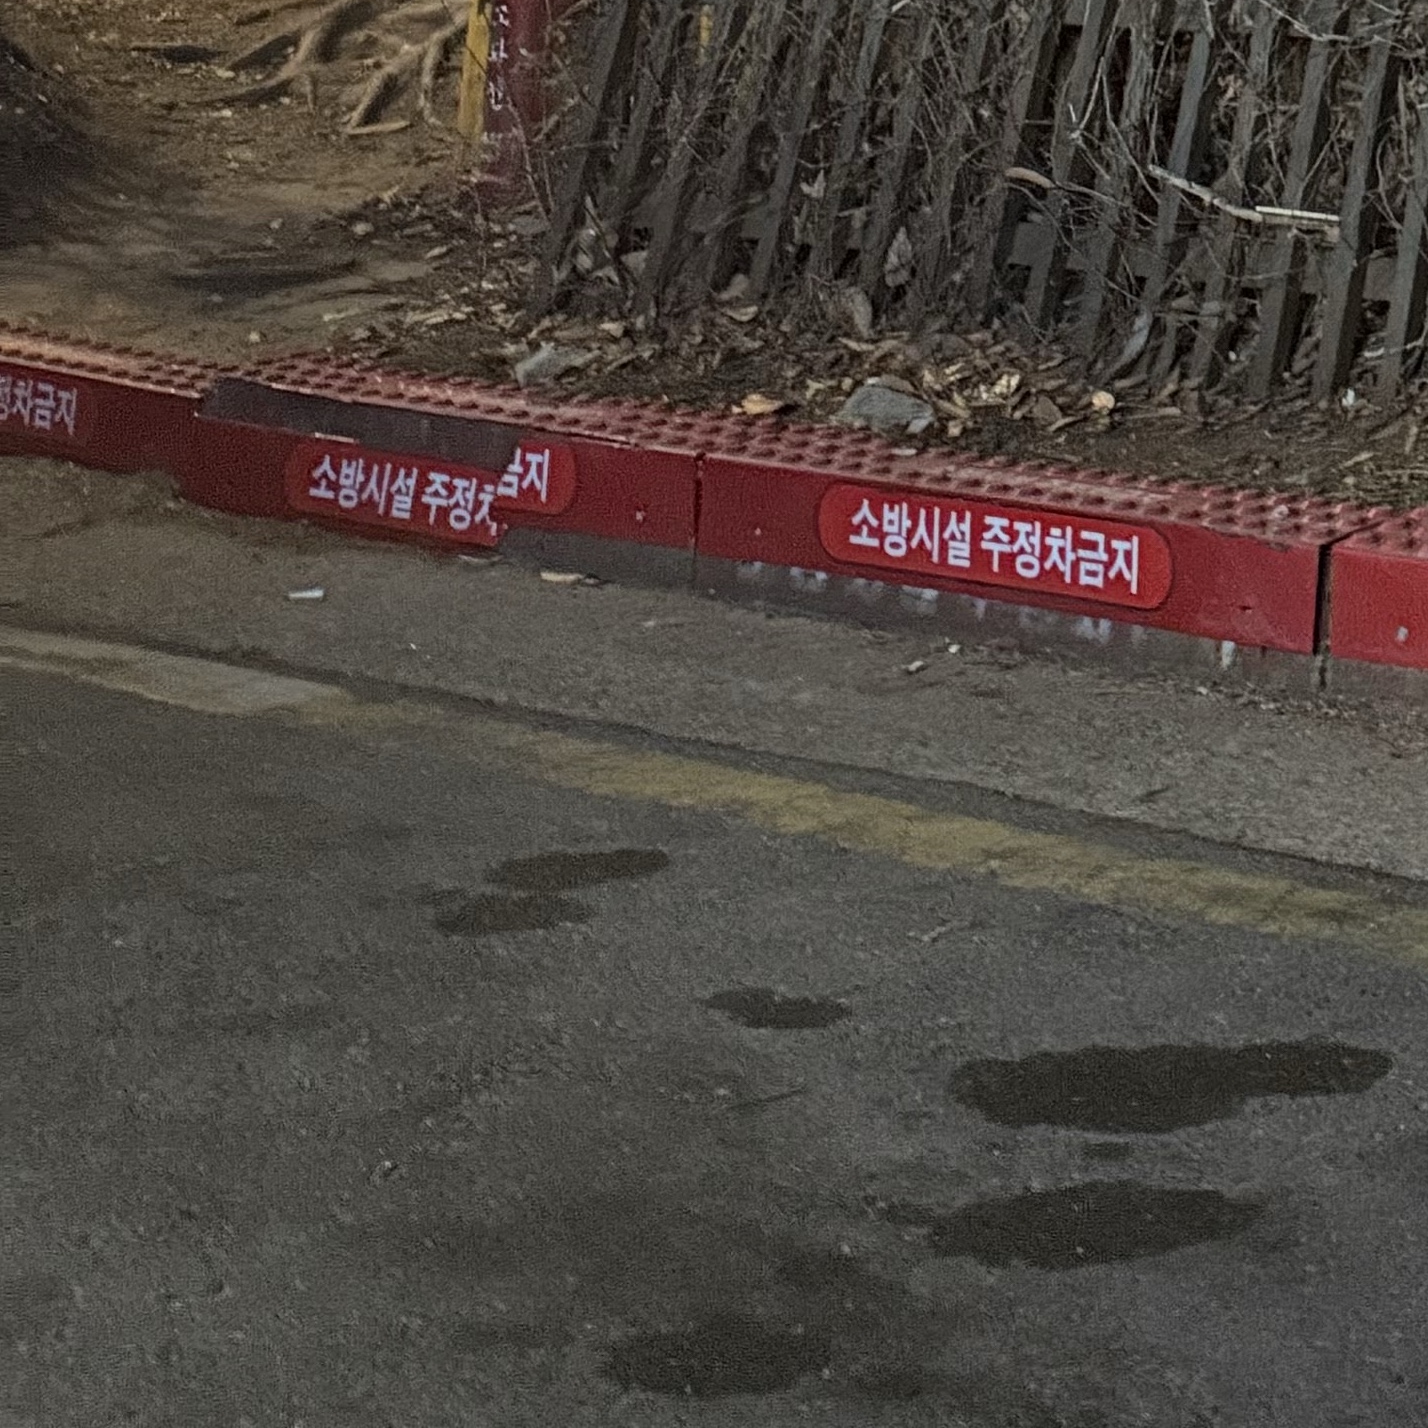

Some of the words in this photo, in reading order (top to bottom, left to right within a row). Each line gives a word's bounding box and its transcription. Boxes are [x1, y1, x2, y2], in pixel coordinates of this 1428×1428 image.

[308, 454, 419, 520] 소방시설
[848, 498, 973, 568] 소방시설
[981, 514, 1140, 595] 주정차금지
